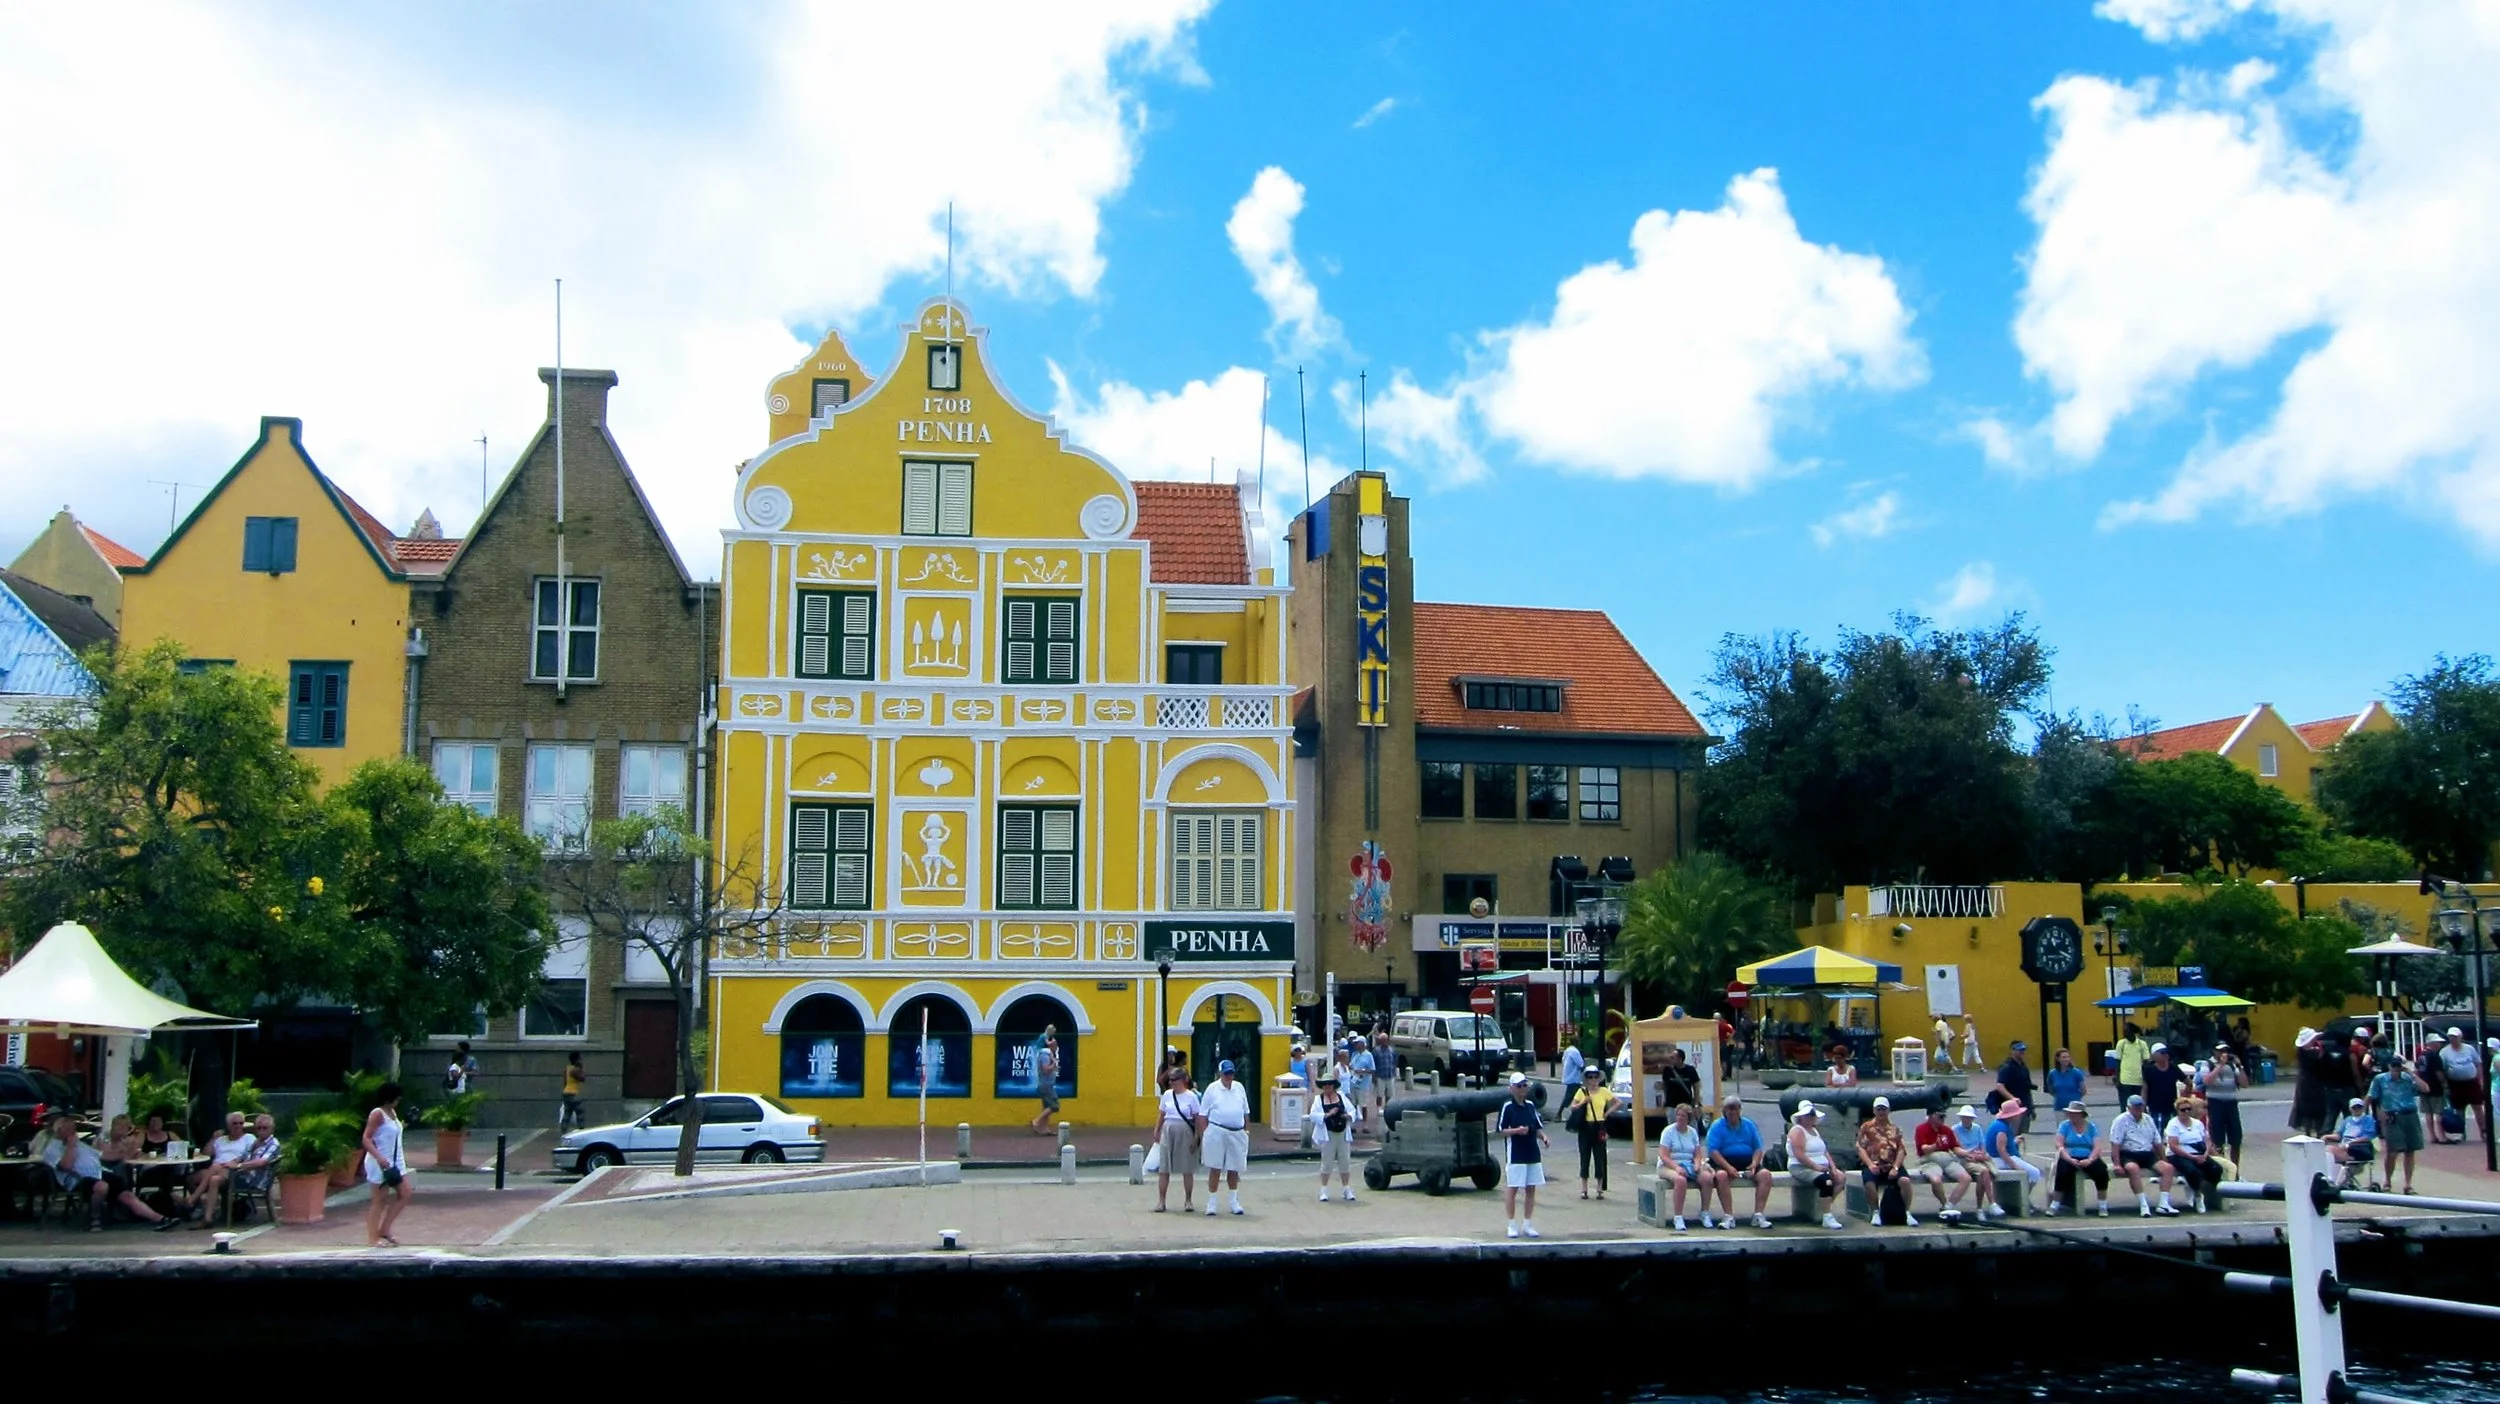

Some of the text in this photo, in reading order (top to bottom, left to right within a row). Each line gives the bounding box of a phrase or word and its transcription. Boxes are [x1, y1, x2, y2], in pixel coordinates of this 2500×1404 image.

[818, 361, 846, 372] 1960
[923, 397, 972, 414] 1708
[898, 420, 993, 444] PENHA
[1169, 930, 1271, 952] PENHA
[808, 1045, 839, 1058] JOIN
[808, 1059, 838, 1074] THE
[1012, 1059, 1022, 1069] IS
[1023, 1060, 1030, 1069] A
